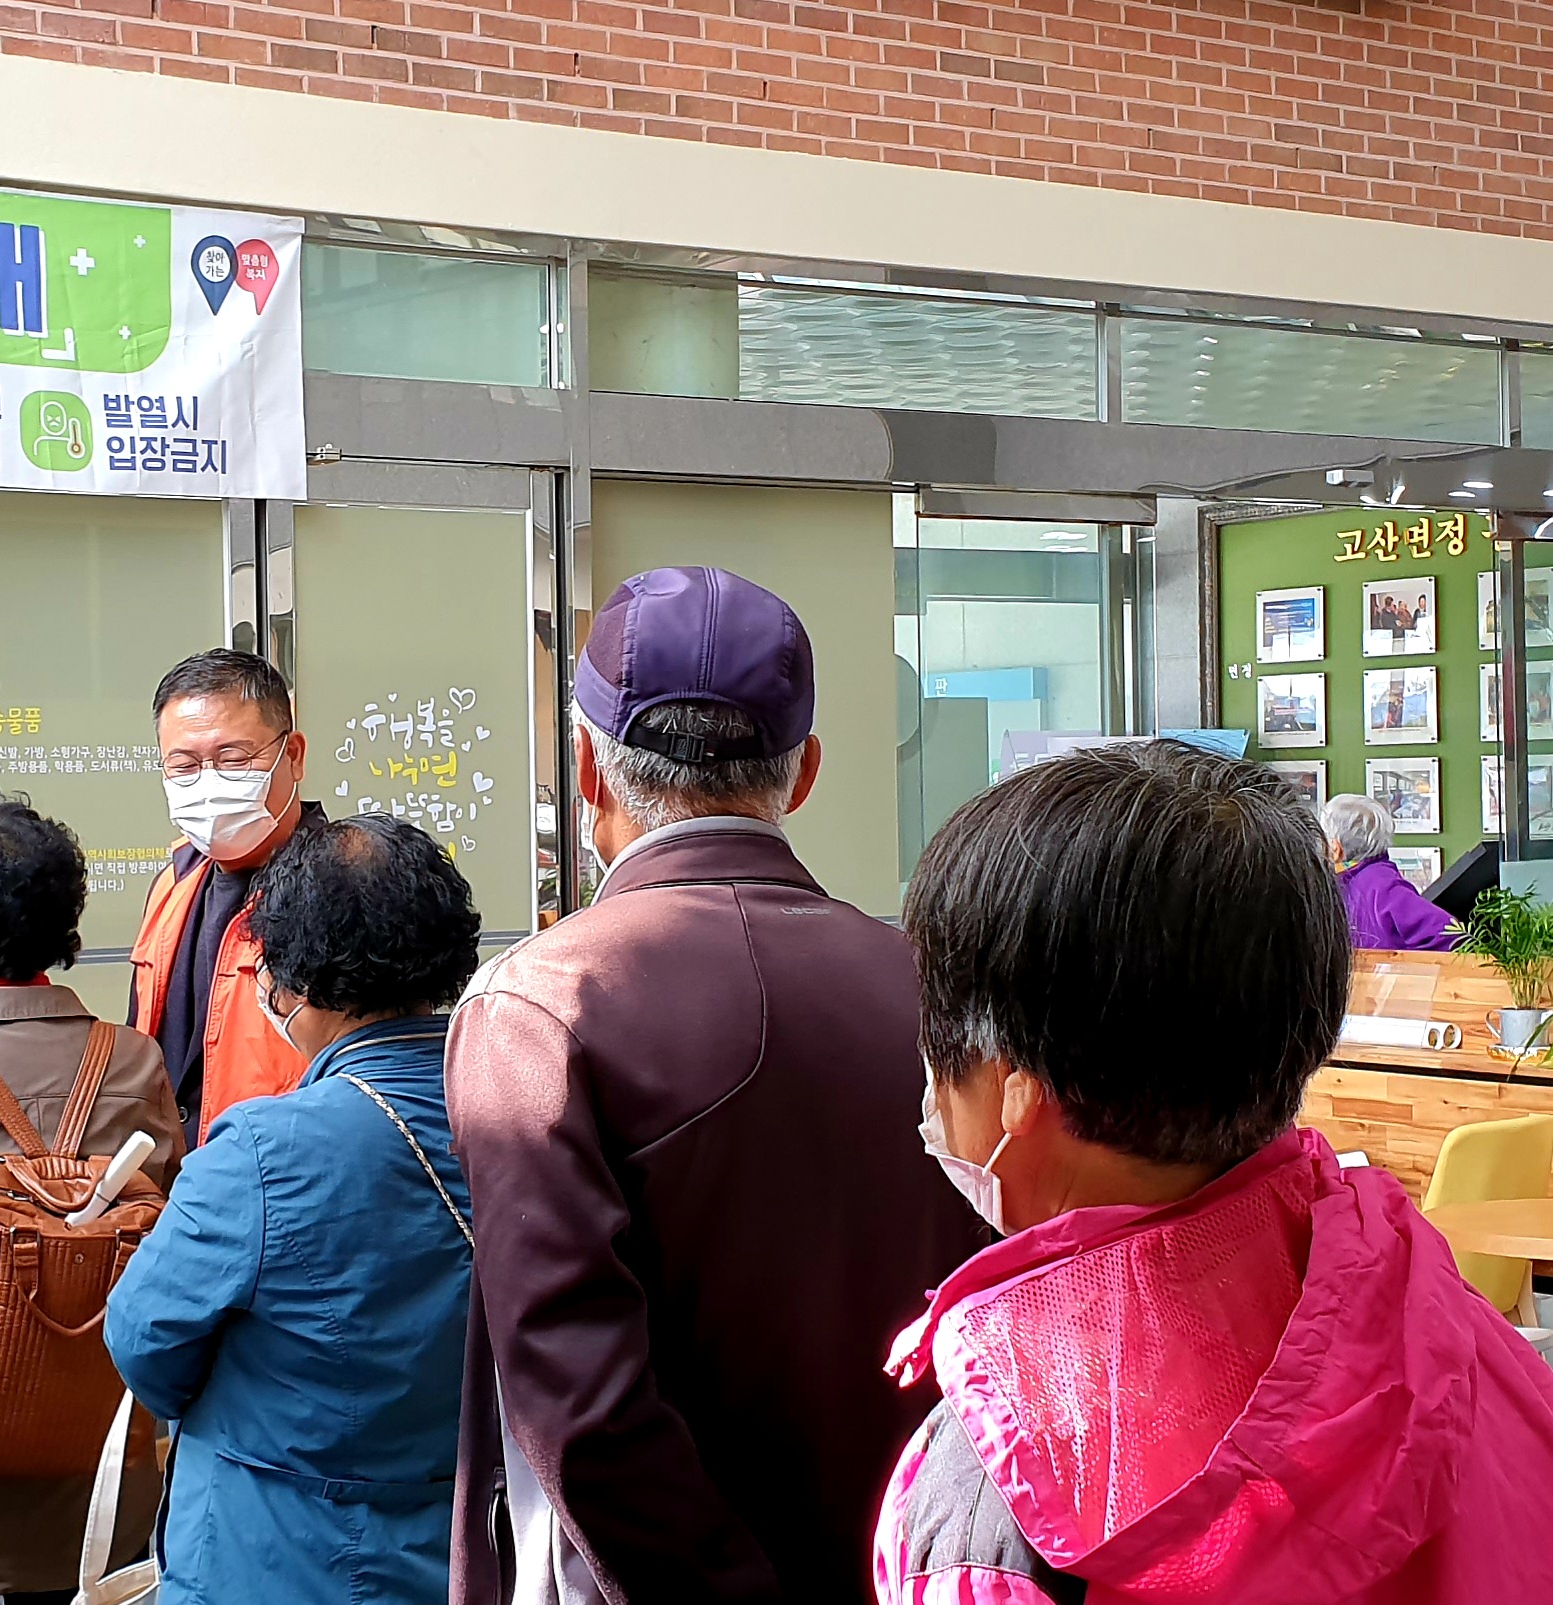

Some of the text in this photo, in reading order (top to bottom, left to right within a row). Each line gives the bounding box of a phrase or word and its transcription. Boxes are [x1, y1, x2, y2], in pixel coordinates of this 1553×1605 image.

[205, 265, 225, 278] 가는
[206, 251, 225, 264] 찾아
[246, 268, 266, 281] 복지
[103, 393, 199, 431] 발열시
[106, 435, 227, 475] 입장금지
[1333, 513, 1465, 562] 고산면정
[361, 697, 455, 750] 행복을
[369, 751, 457, 787] 나누면
[107, 862, 126, 875] 직접
